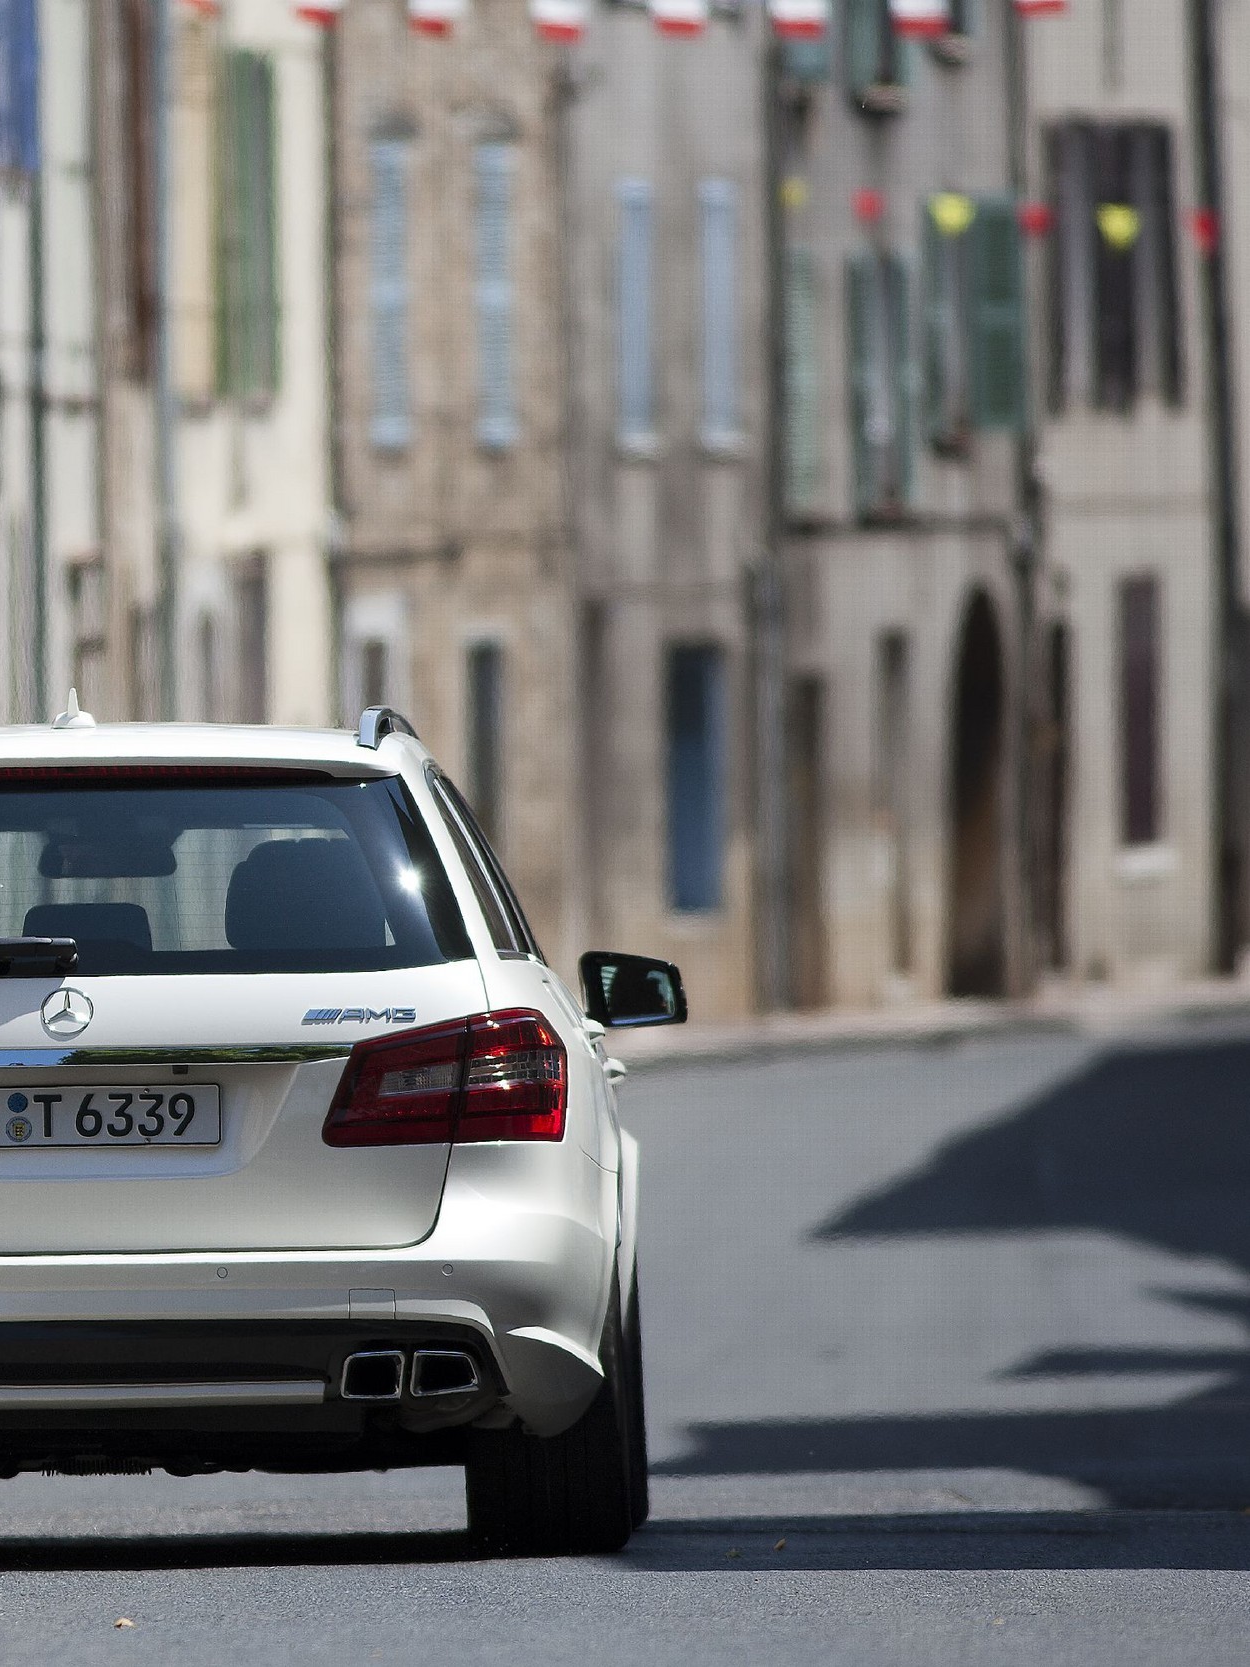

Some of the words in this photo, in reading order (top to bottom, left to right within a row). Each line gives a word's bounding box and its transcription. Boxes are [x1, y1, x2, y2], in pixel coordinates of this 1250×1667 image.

[338, 1007, 416, 1025] AMG
[33, 1093, 63, 1138] T
[75, 1092, 195, 1138] 6339
